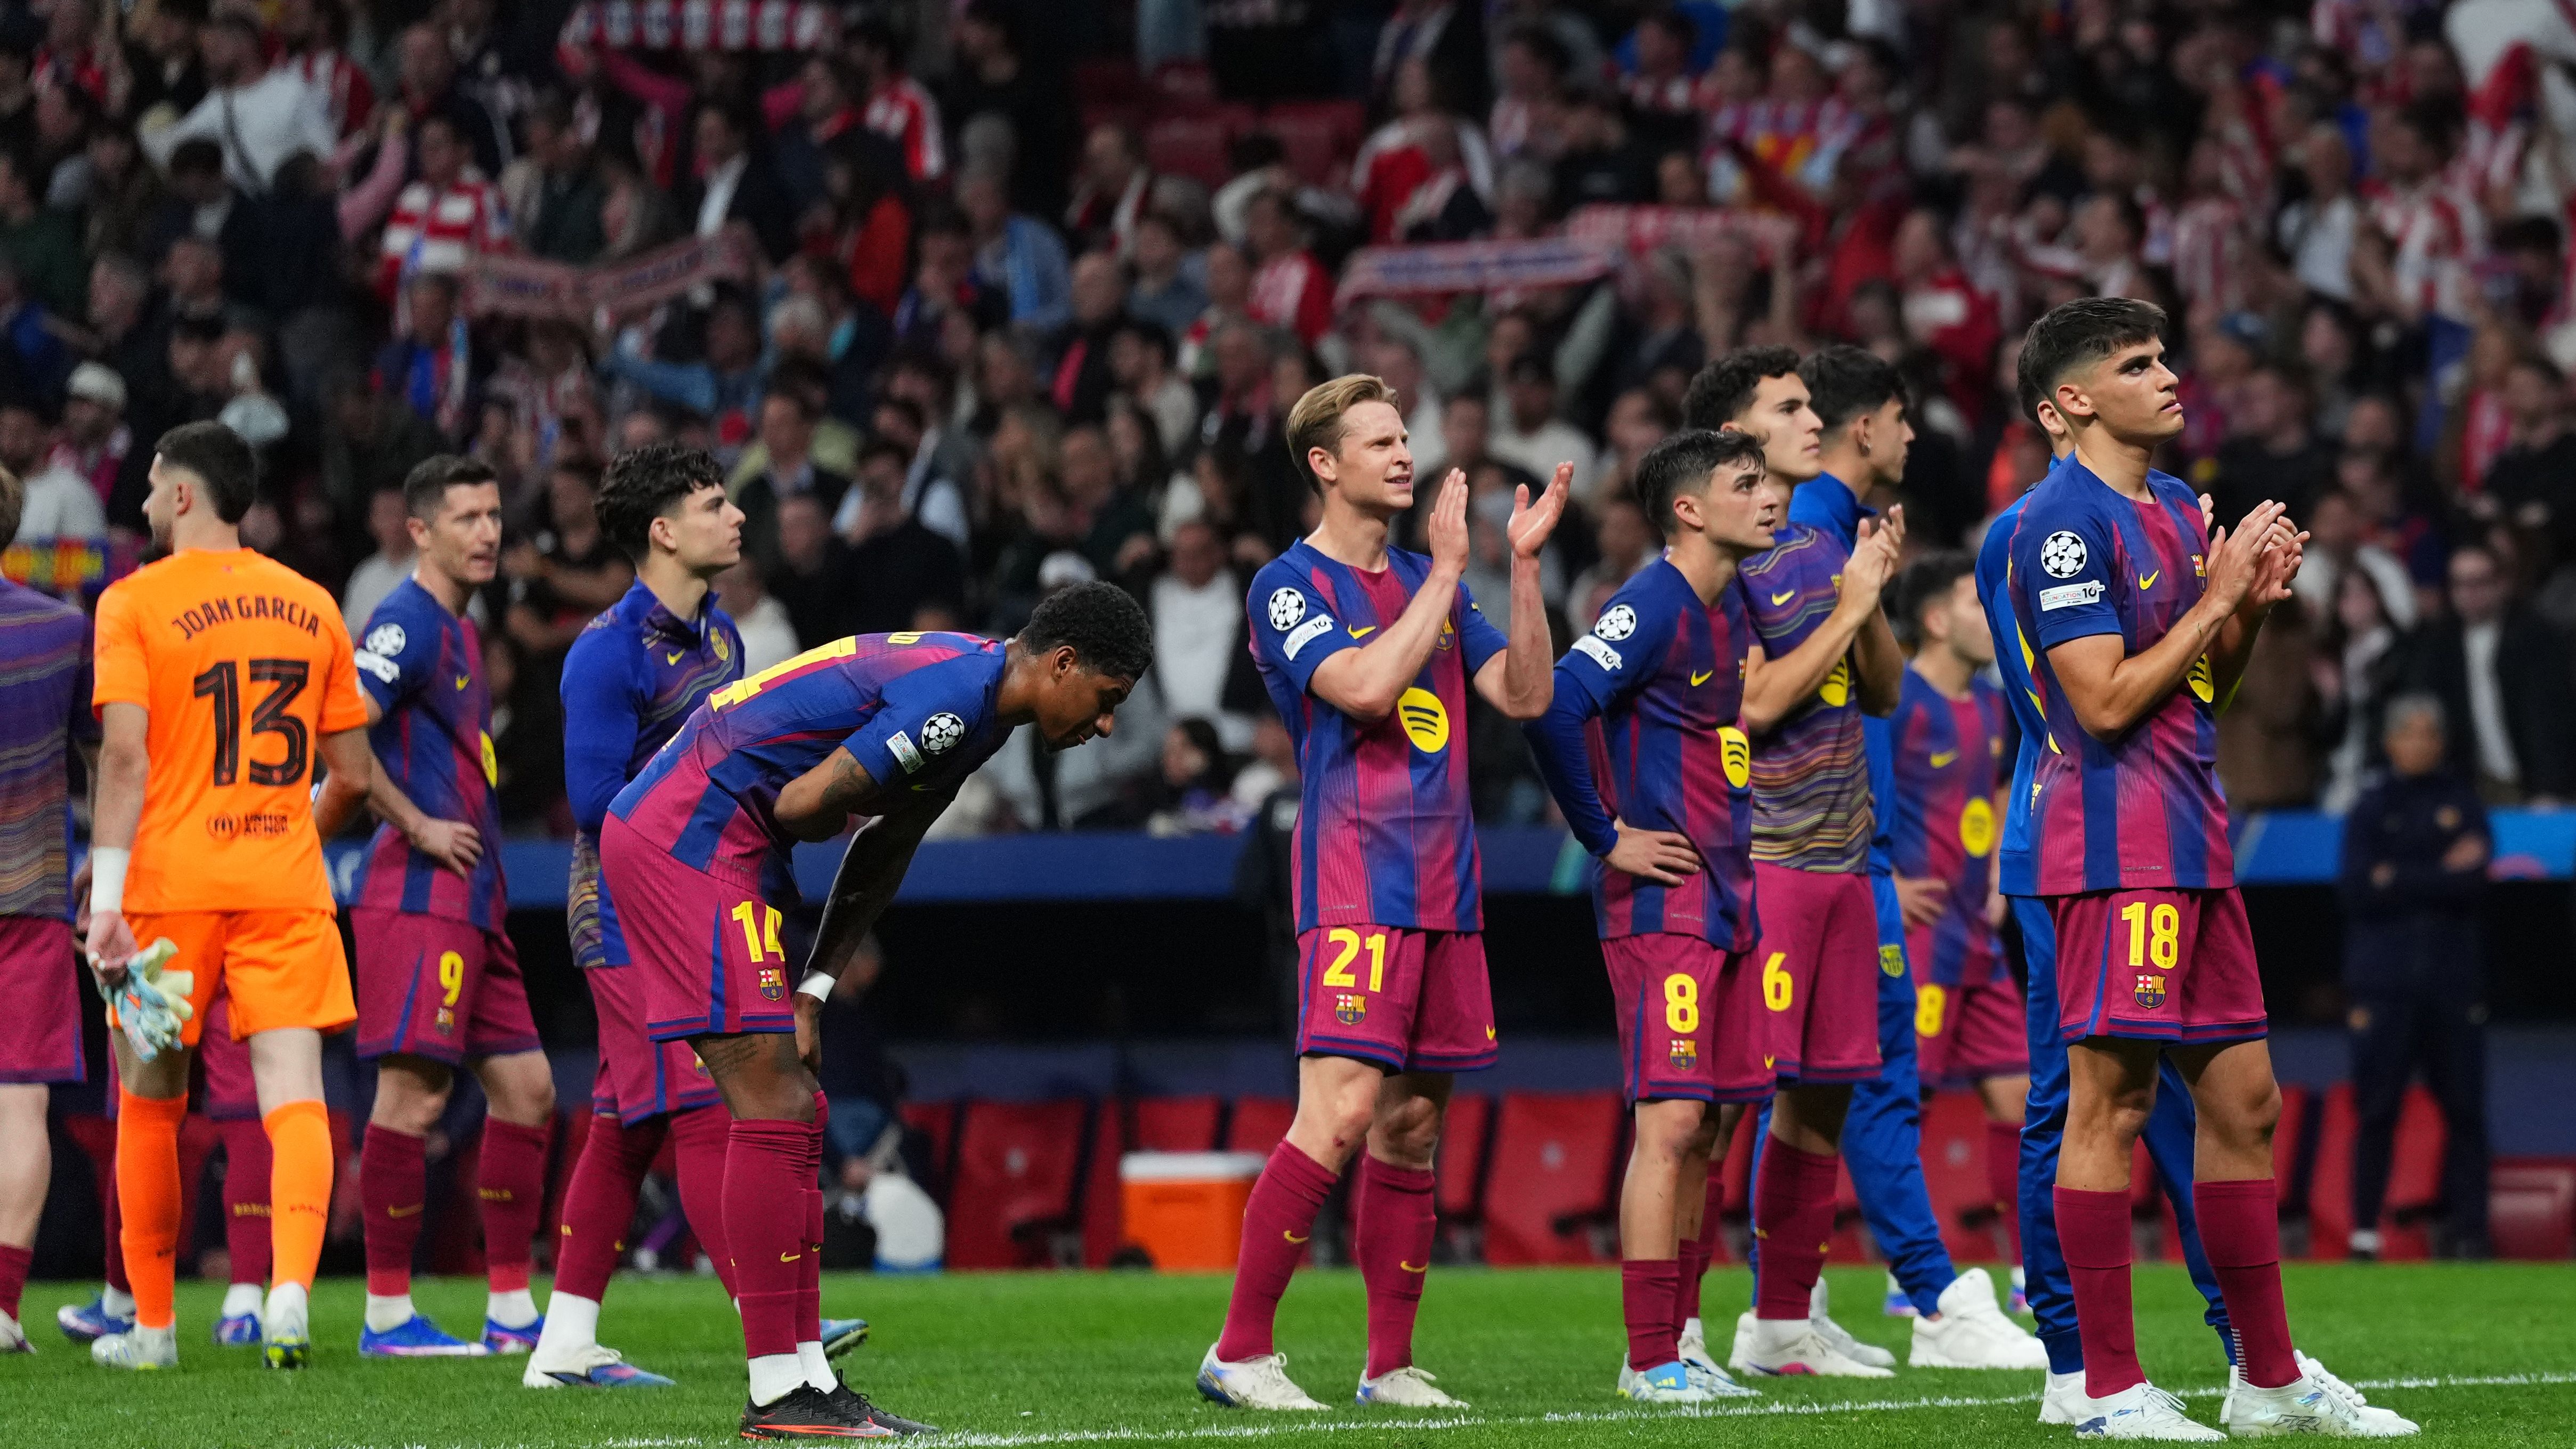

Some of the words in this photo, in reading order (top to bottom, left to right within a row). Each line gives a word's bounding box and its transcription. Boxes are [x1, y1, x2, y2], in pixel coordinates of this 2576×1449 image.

[2057, 545, 2070, 564] 5
[172, 596, 234, 640] JOAN
[237, 594, 320, 638] GARCIA
[2042, 592, 2081, 603] FOUNDATION
[194, 659, 310, 787] 13
[935, 727, 953, 743] 5
[732, 901, 785, 963] 14
[1323, 928, 1386, 993] 21
[2121, 902, 2179, 969] 18
[440, 951, 464, 1007] 9
[1664, 973, 1699, 1034] 8
[1762, 952, 1793, 1012] 6
[1915, 984, 1945, 1038] 8
